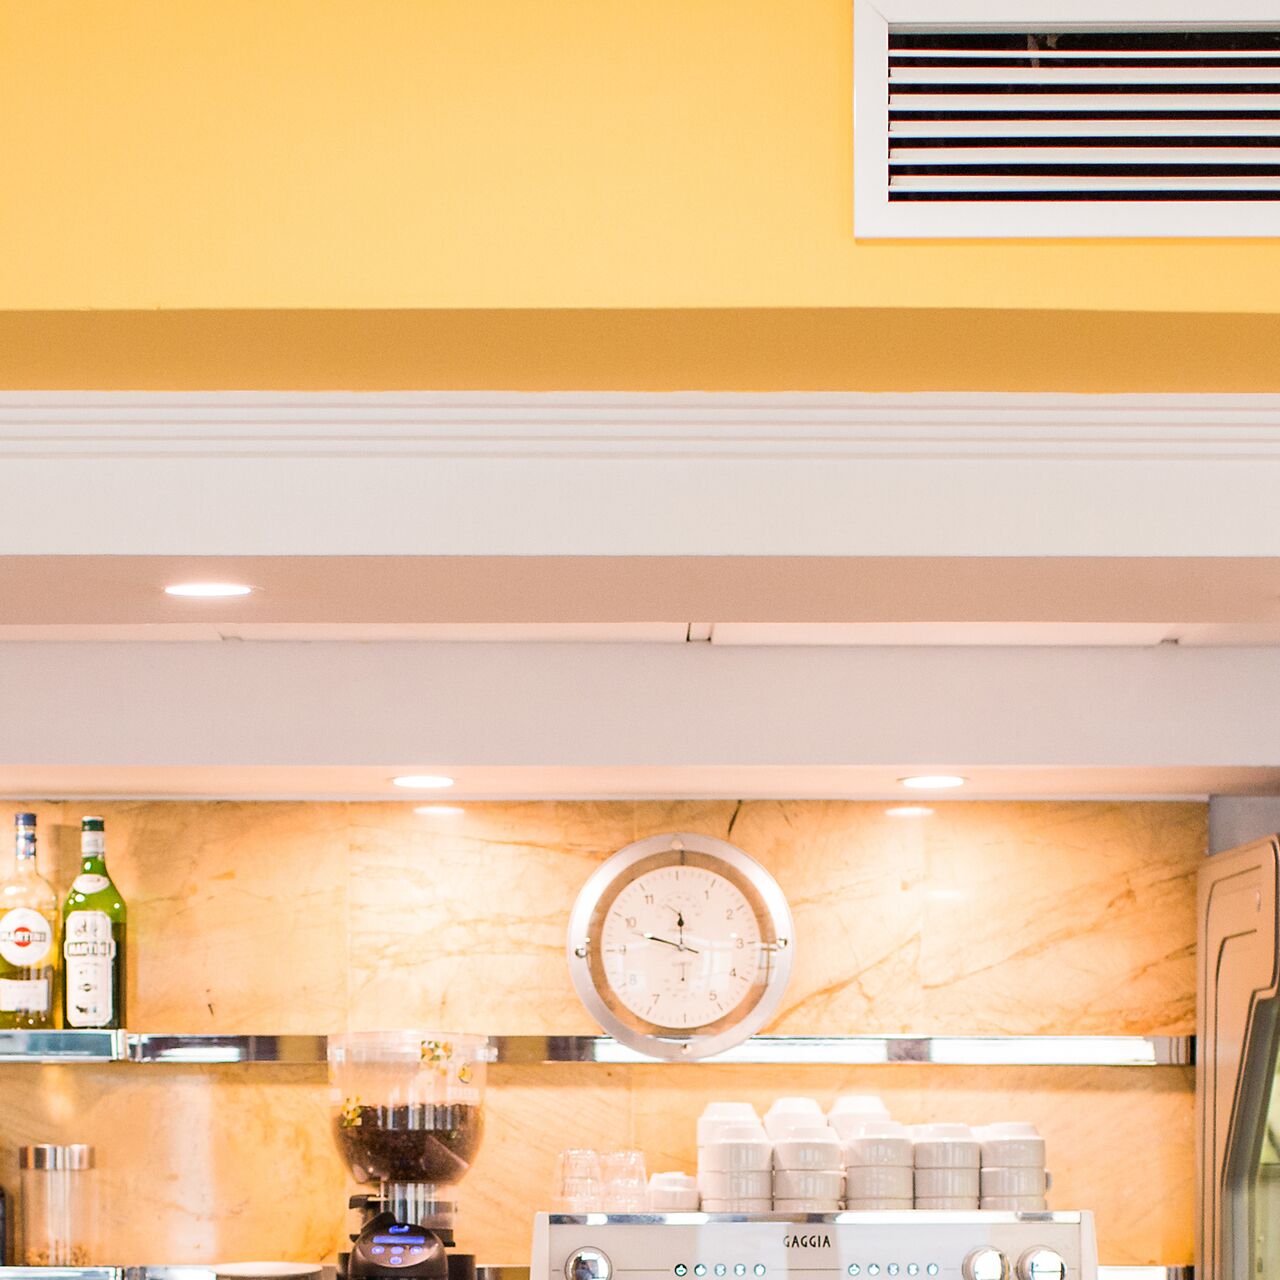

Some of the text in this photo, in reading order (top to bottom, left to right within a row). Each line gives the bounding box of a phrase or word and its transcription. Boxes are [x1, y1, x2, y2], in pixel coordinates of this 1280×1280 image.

[645, 894, 654, 904] 11
[705, 890, 709, 900] 1
[726, 909, 734, 920] 2
[625, 917, 637, 928] 10
[736, 938, 744, 949] 3
[729, 968, 737, 978] 4
[652, 993, 660, 1004] 7
[709, 991, 717, 1001] 5
[783, 1235, 831, 1248] GAGGIA
